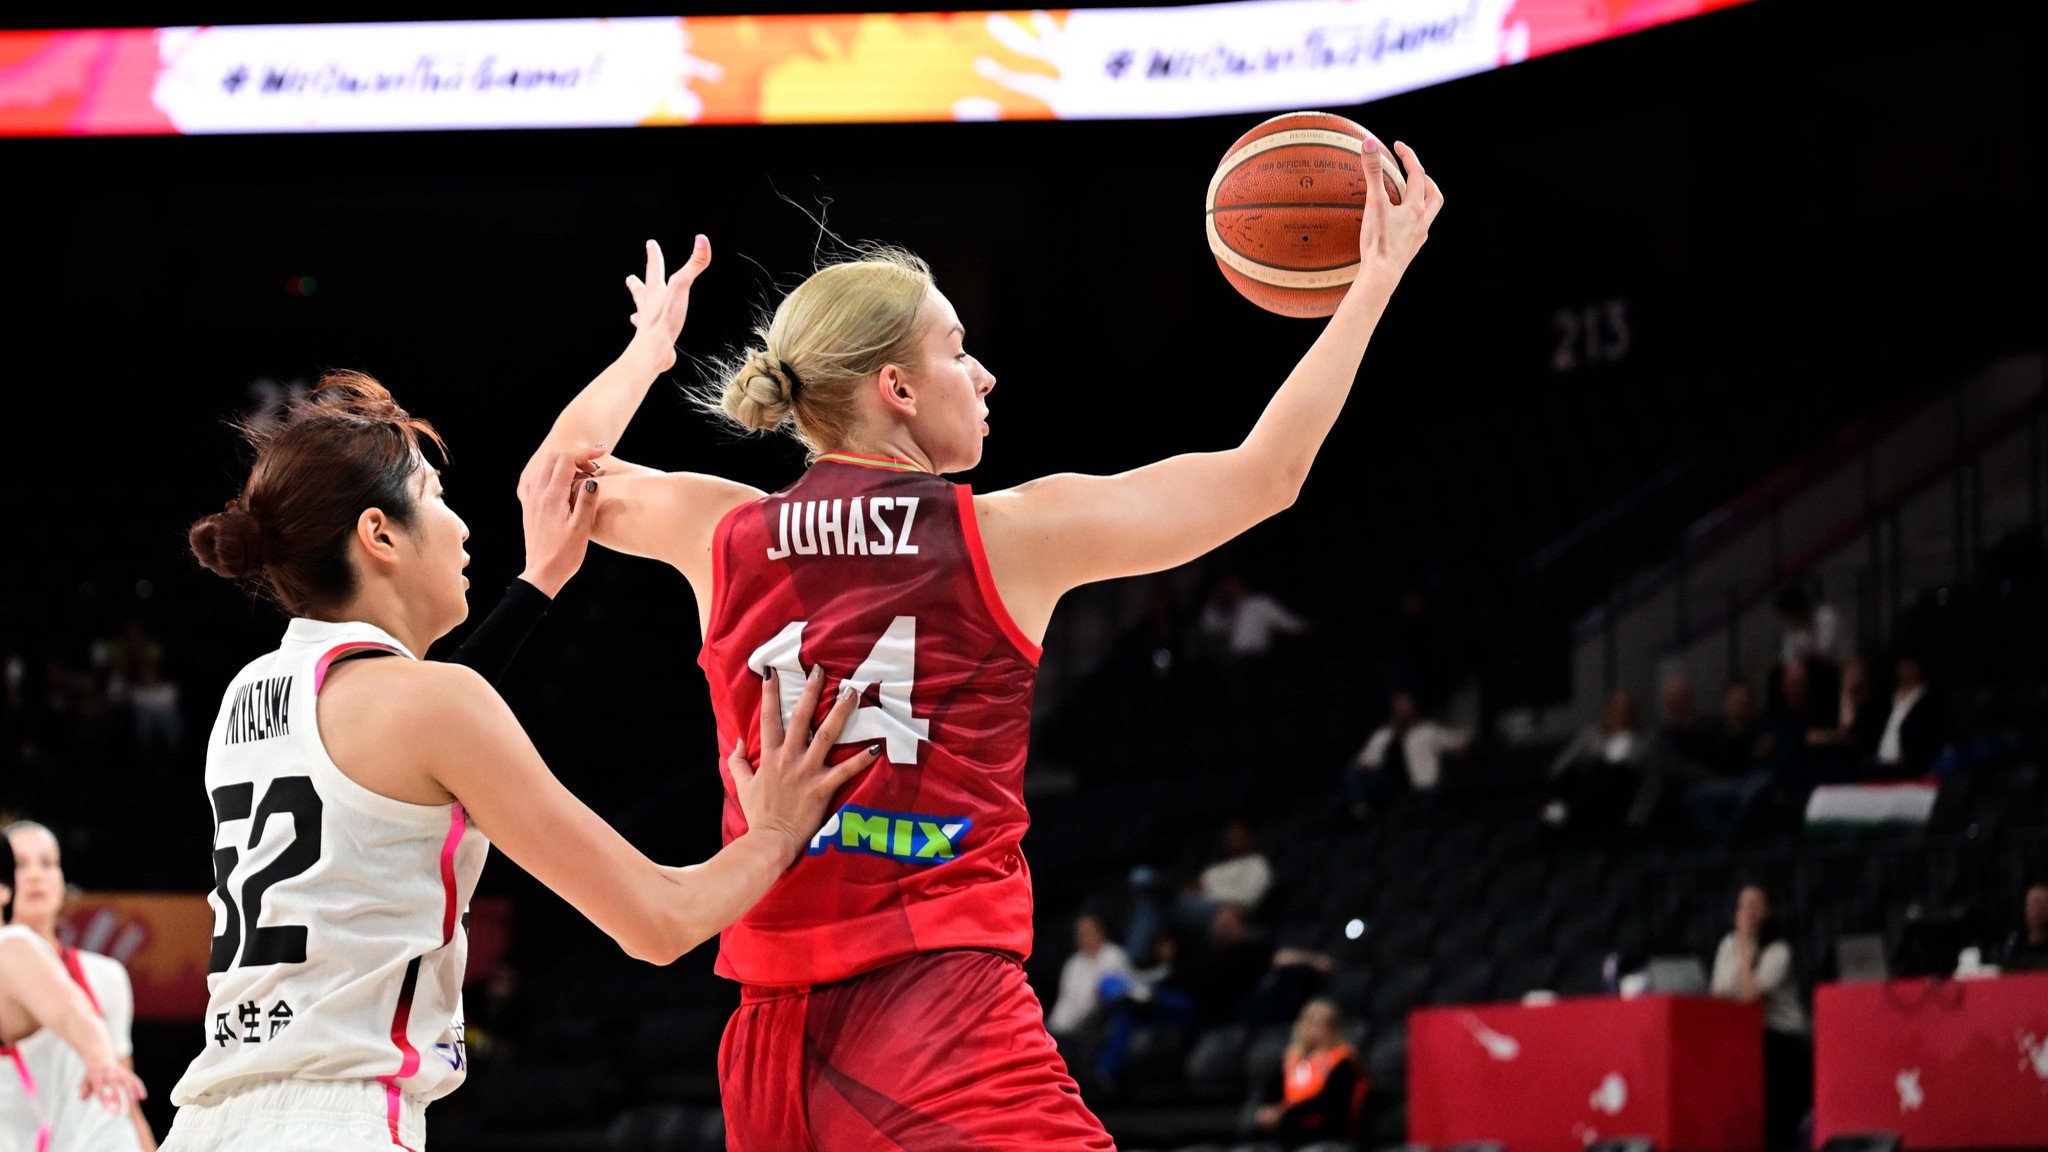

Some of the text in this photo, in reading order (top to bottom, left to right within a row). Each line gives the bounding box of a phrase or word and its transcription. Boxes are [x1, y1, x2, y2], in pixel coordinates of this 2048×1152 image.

[1276, 160, 1312, 169] OFFICIAL
[1313, 160, 1336, 169] GAME
[1338, 161, 1358, 173] BALL
[225, 675, 293, 745] MIYAZAWA
[748, 615, 929, 765] 14
[208, 775, 323, 976] 52
